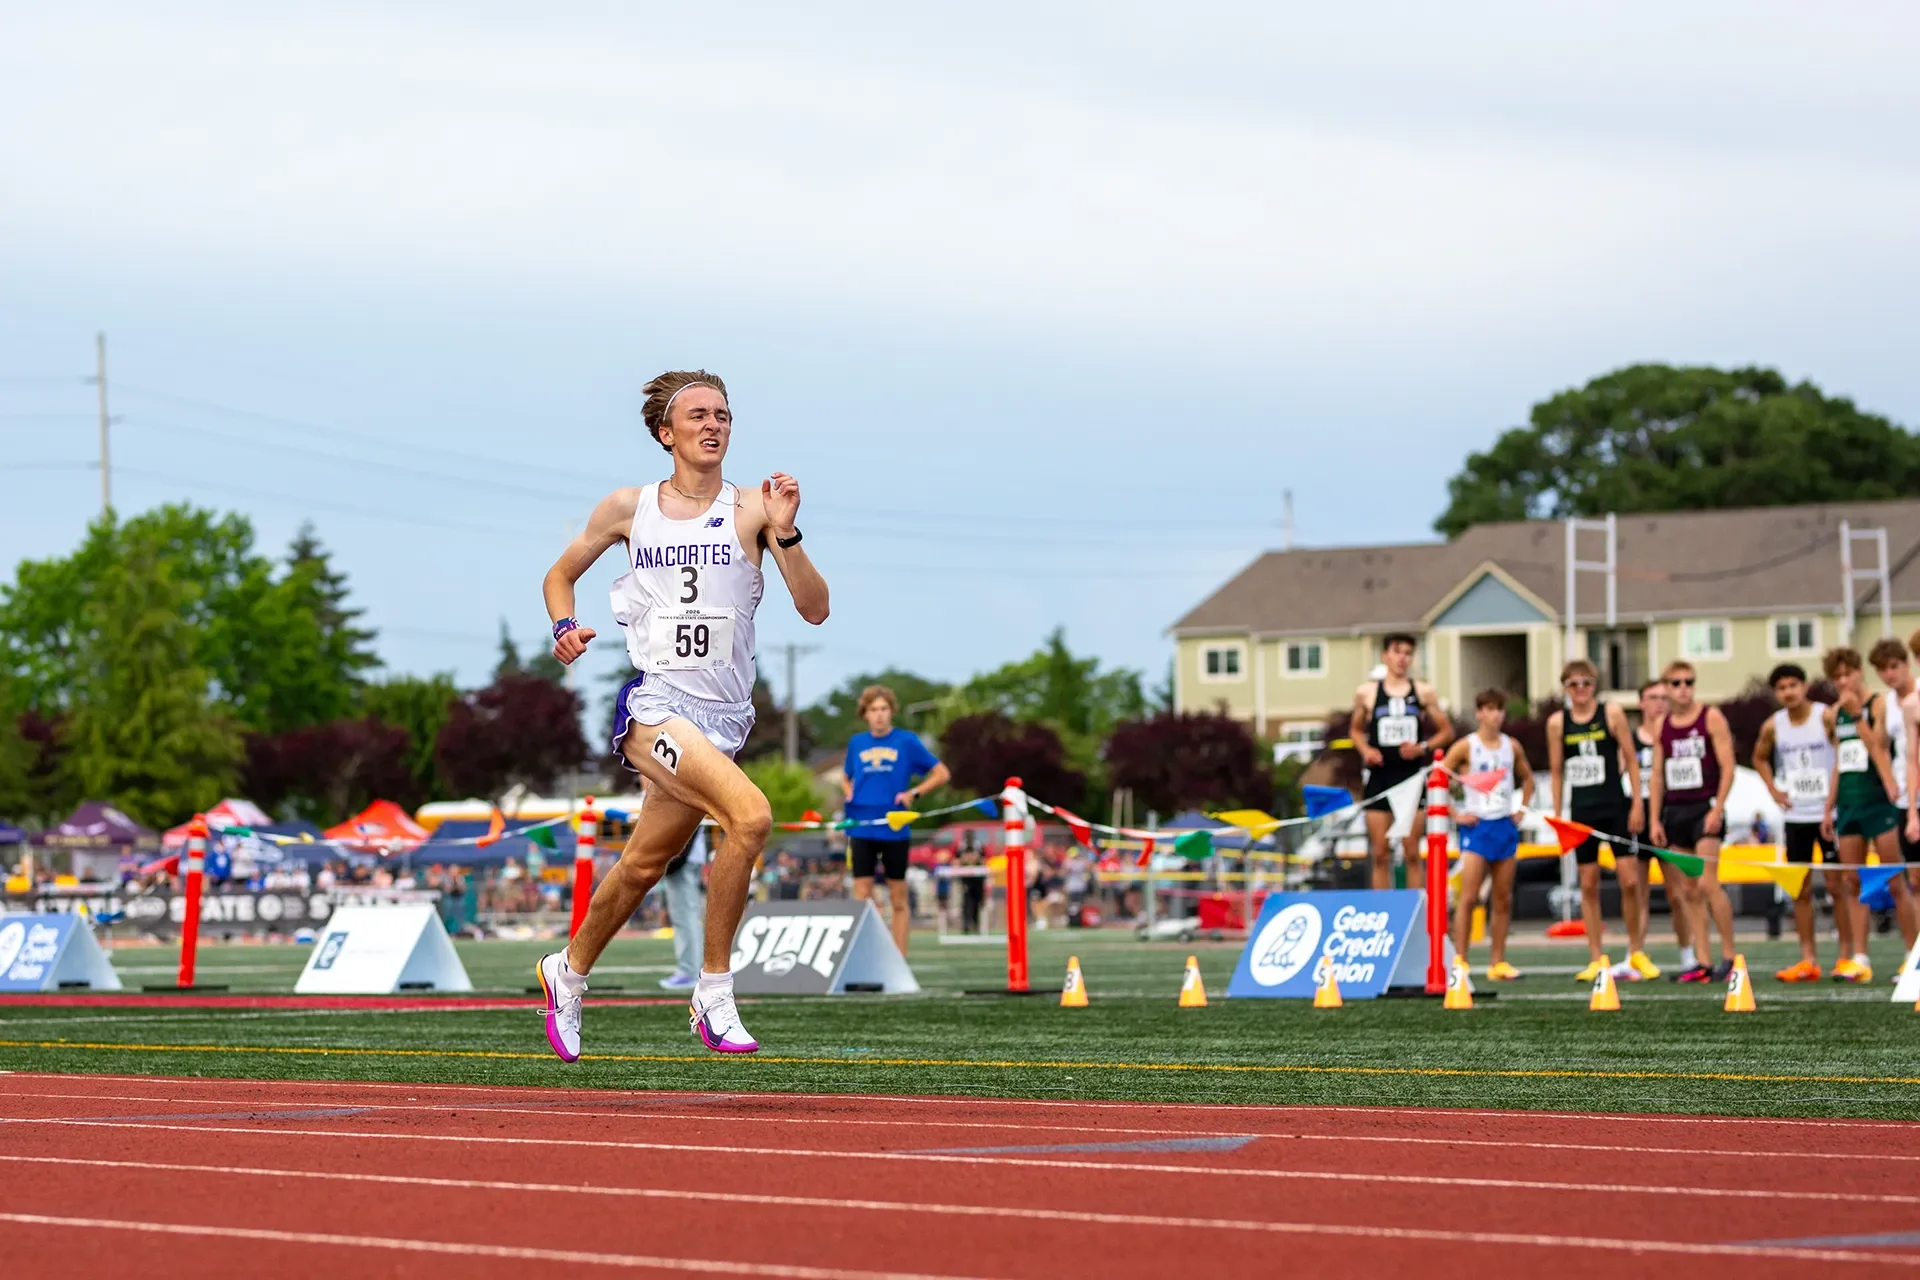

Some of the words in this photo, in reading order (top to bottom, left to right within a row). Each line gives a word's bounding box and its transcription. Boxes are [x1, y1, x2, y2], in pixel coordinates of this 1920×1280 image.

[635, 544, 730, 569] ANACORTES
[680, 566, 698, 604] 3
[676, 624, 709, 658] 59
[654, 739, 677, 769] 3
[169, 895, 256, 922] SATE
[1333, 905, 1389, 932] Gesa
[730, 915, 855, 978] STATE
[1323, 930, 1395, 957] Credit
